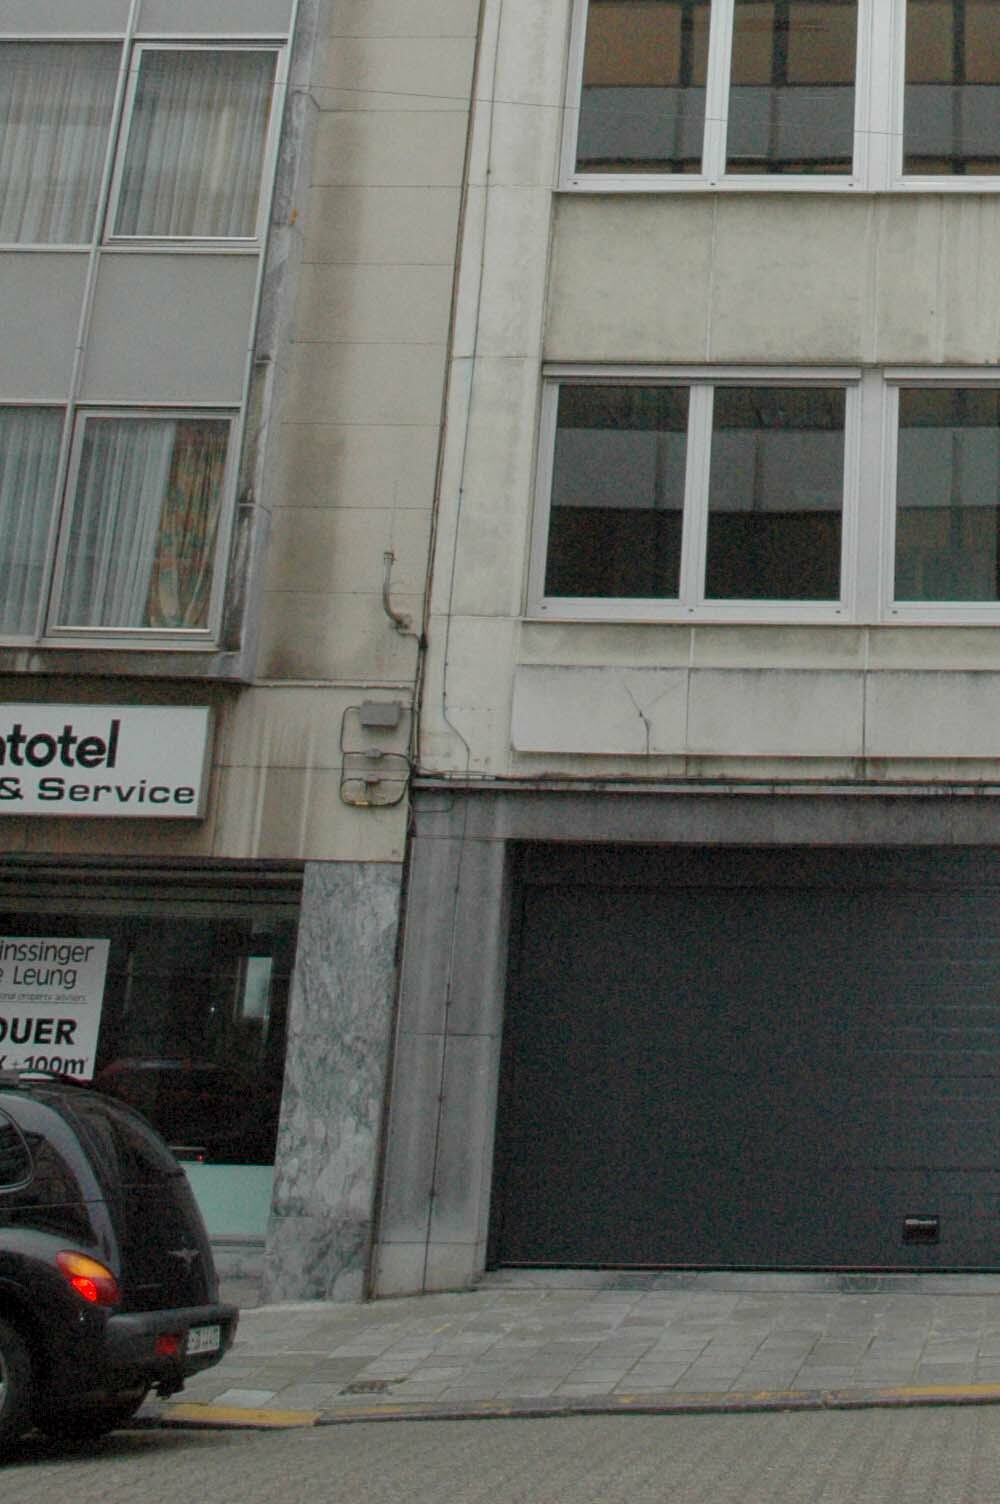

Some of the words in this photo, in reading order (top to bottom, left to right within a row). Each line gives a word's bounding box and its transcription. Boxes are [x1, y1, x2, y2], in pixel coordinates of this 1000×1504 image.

[0, 719, 121, 768] totel
[38, 777, 195, 804] Service
[13, 966, 77, 989] Leung
